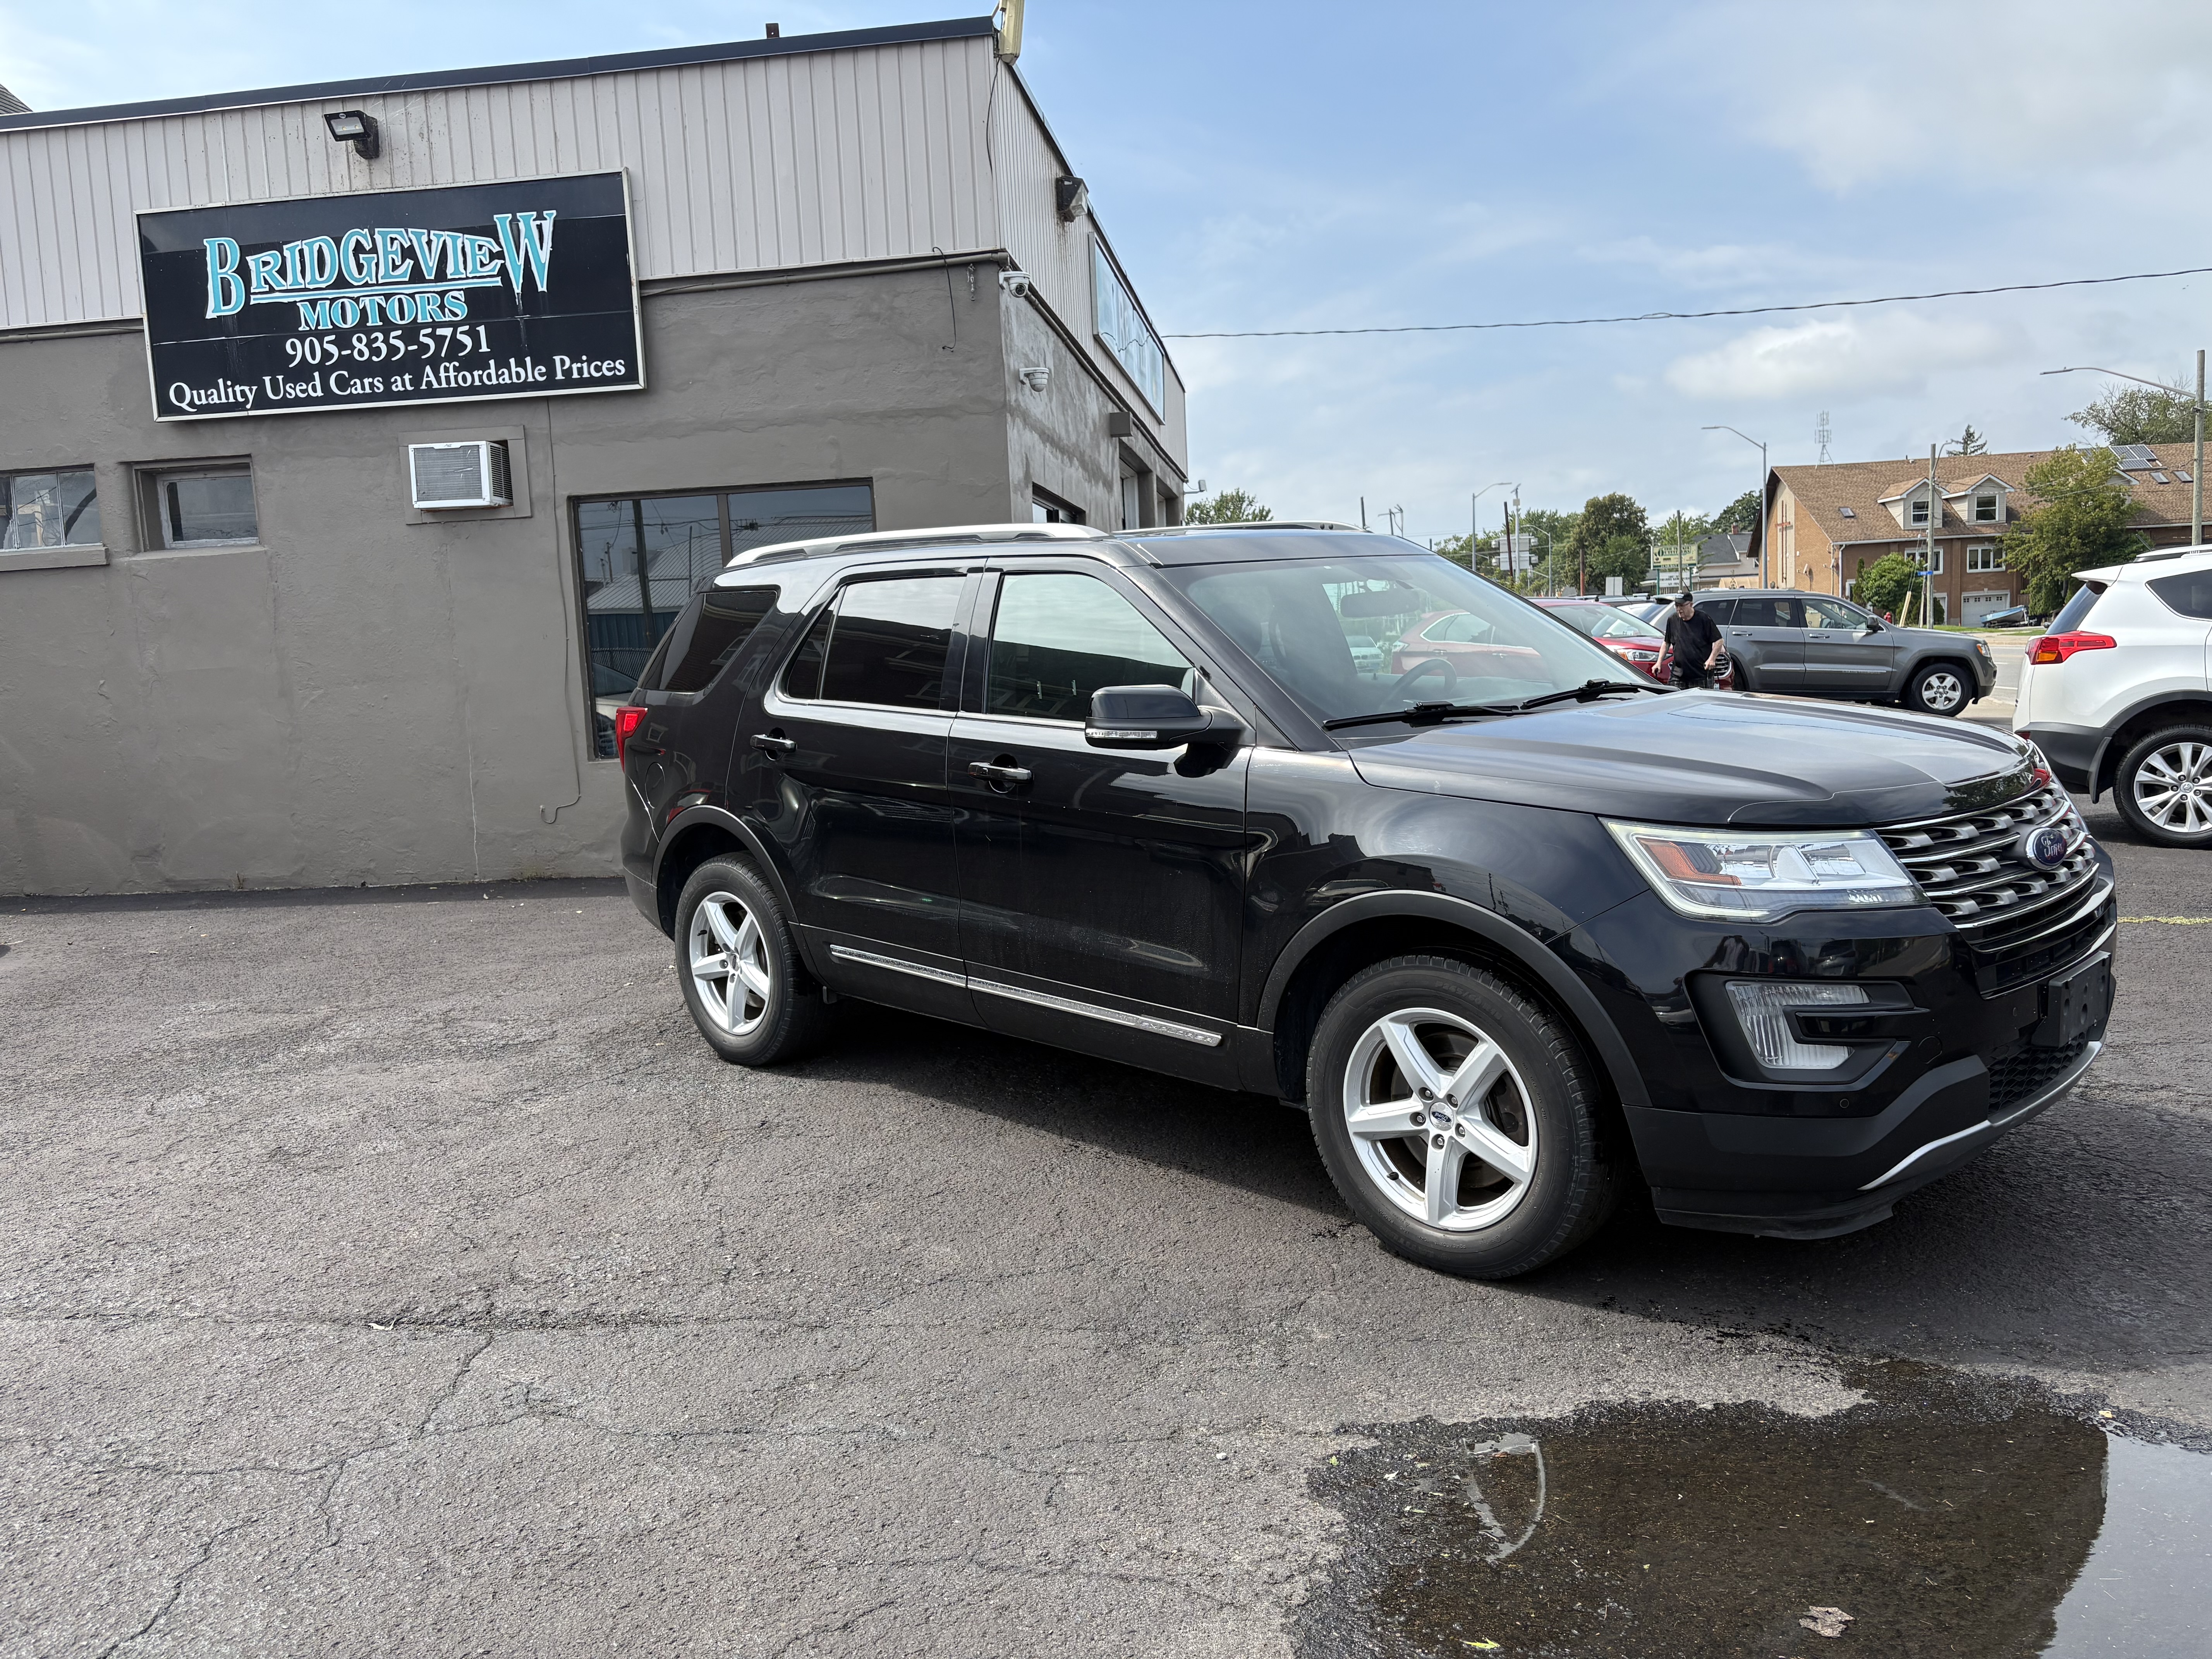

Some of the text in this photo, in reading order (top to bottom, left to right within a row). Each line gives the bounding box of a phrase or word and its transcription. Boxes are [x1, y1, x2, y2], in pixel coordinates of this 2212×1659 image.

[203, 210, 556, 319] BRIDGEVIEW
[296, 291, 467, 331] MOTORS
[285, 325, 491, 368] 905-835-5751
[169, 354, 626, 412] Quality Used Cars at Affordable Prices
[2041, 834, 2064, 859] Ford
[1140, 1021, 1213, 1043] EXPLORER
[1434, 1112, 1448, 1122] Ford
